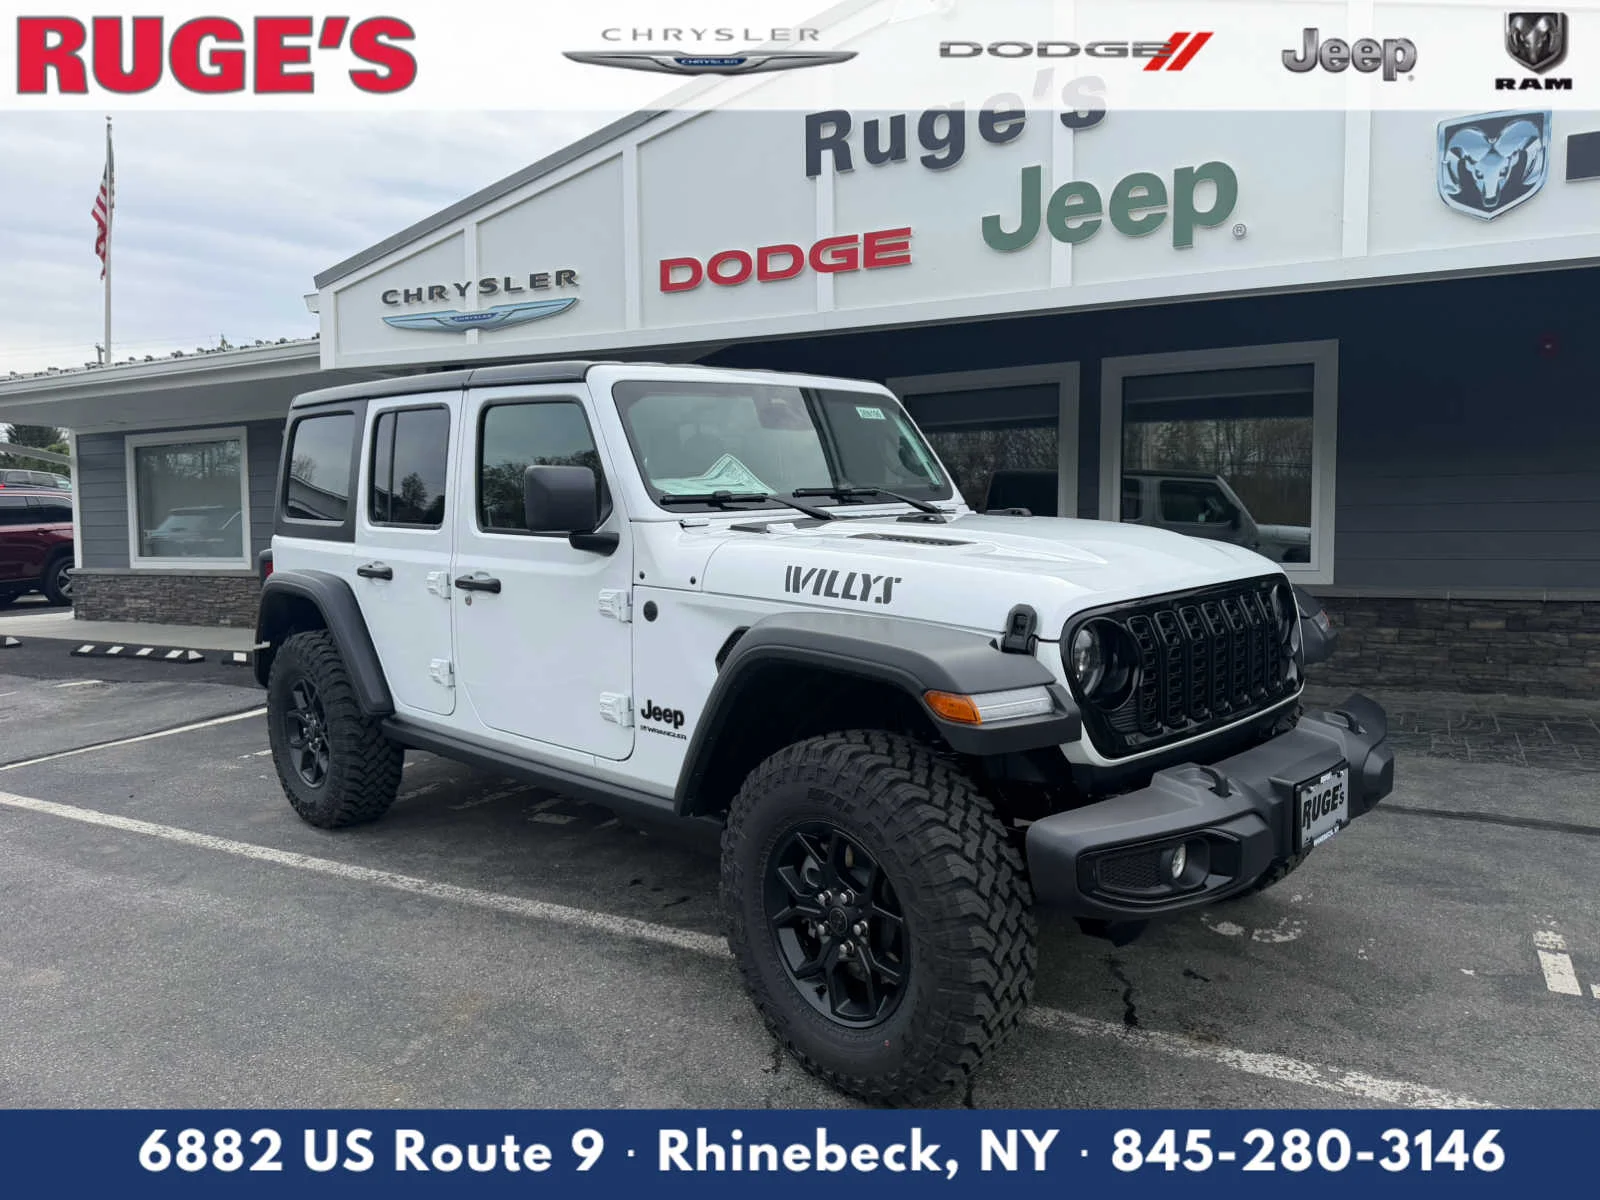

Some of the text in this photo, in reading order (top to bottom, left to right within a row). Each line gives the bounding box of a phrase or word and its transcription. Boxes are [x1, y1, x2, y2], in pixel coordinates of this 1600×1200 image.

[804, 67, 1108, 179] Ruge's
[981, 159, 1239, 252] Jeep
[658, 226, 913, 293] DODGE
[381, 268, 580, 306] CHRYSLER
[785, 565, 902, 604] WILLYS
[640, 699, 685, 730] Jeep
